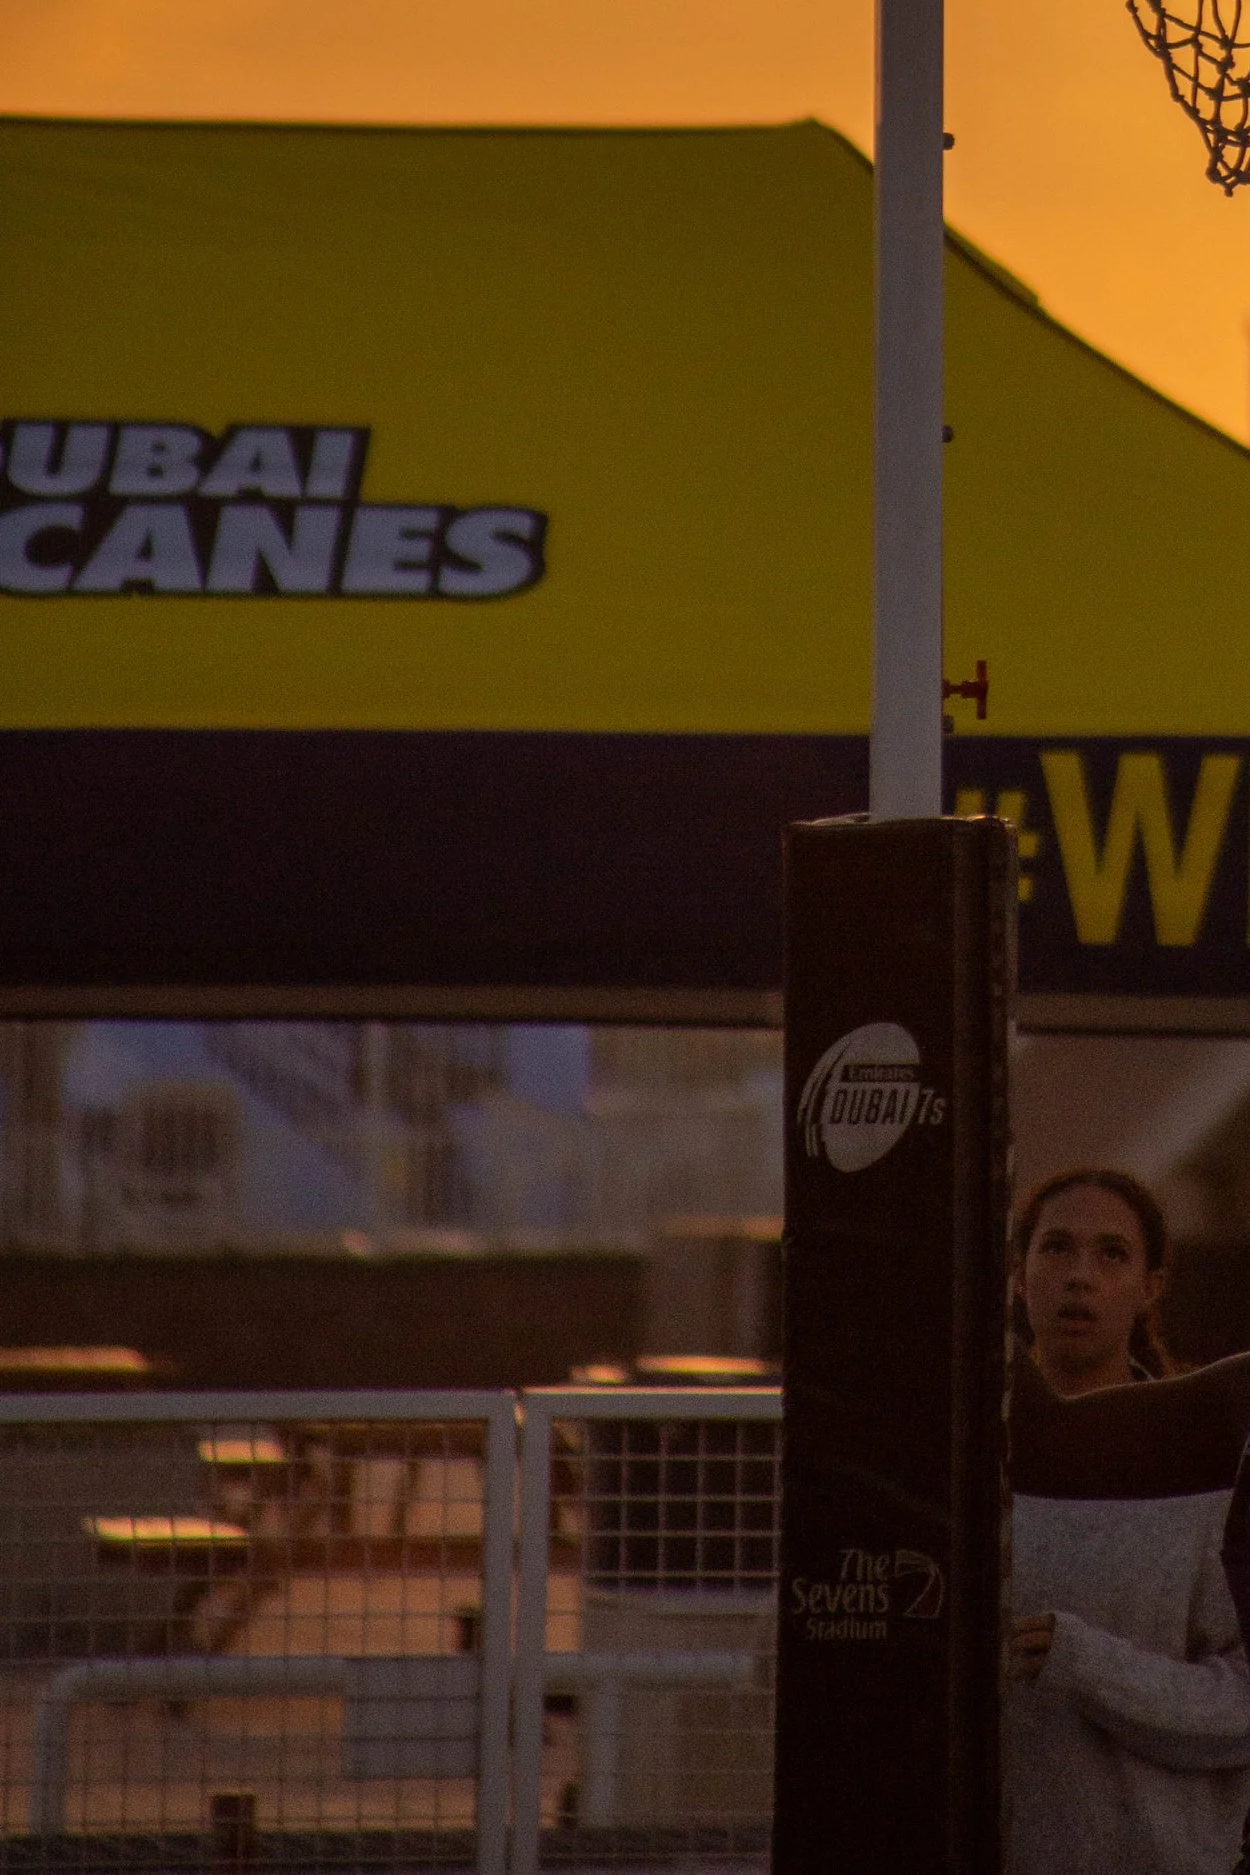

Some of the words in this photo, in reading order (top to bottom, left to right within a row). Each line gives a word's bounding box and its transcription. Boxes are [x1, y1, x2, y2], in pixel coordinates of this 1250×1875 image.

[0, 422, 358, 499] UBAI
[829, 1088, 910, 1126] DUBAI
[838, 1548, 891, 1581] The
[791, 1576, 891, 1616] Sevens
